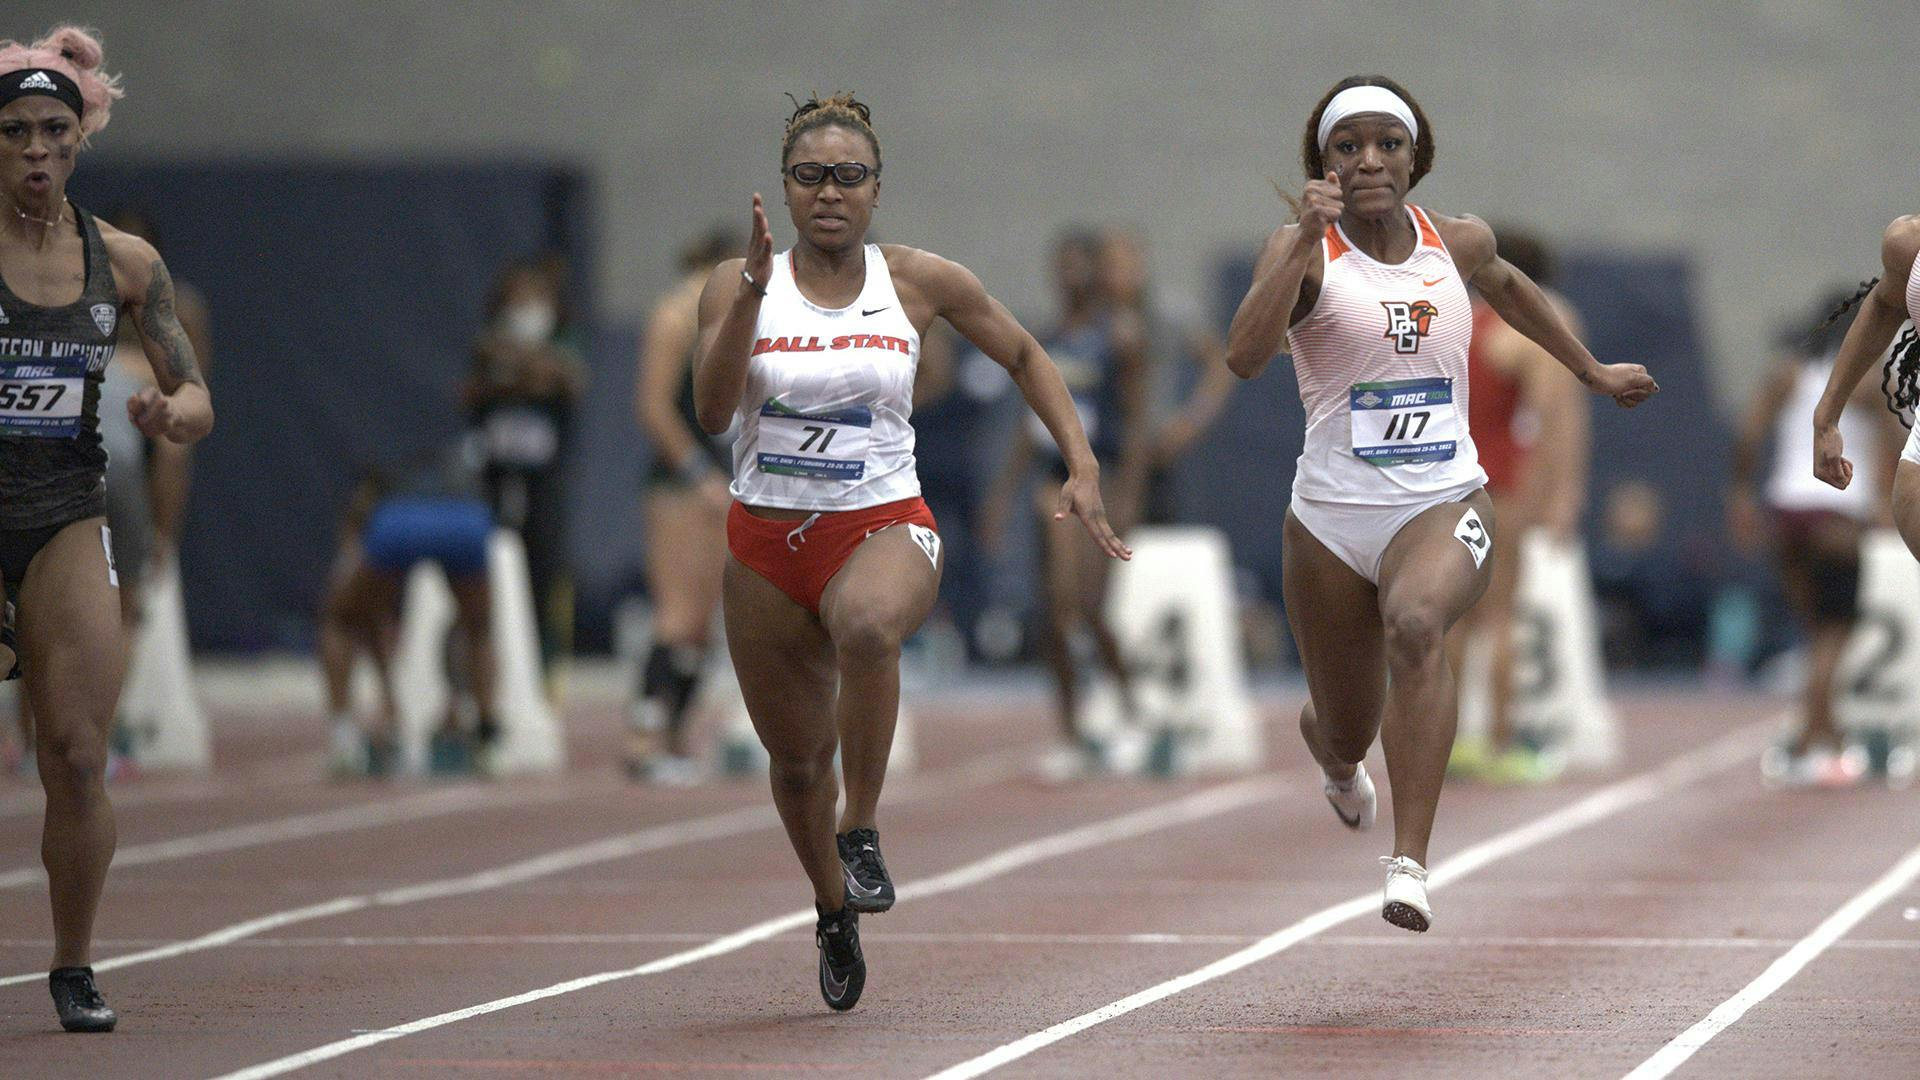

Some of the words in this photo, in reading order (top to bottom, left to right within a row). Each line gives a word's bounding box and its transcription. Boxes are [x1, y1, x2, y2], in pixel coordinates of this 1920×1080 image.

[19, 80, 58, 92] adidas
[751, 336, 826, 357] BALL
[829, 334, 910, 355] STATE
[1383, 411, 1431, 441] 117
[798, 425, 838, 453] 71
